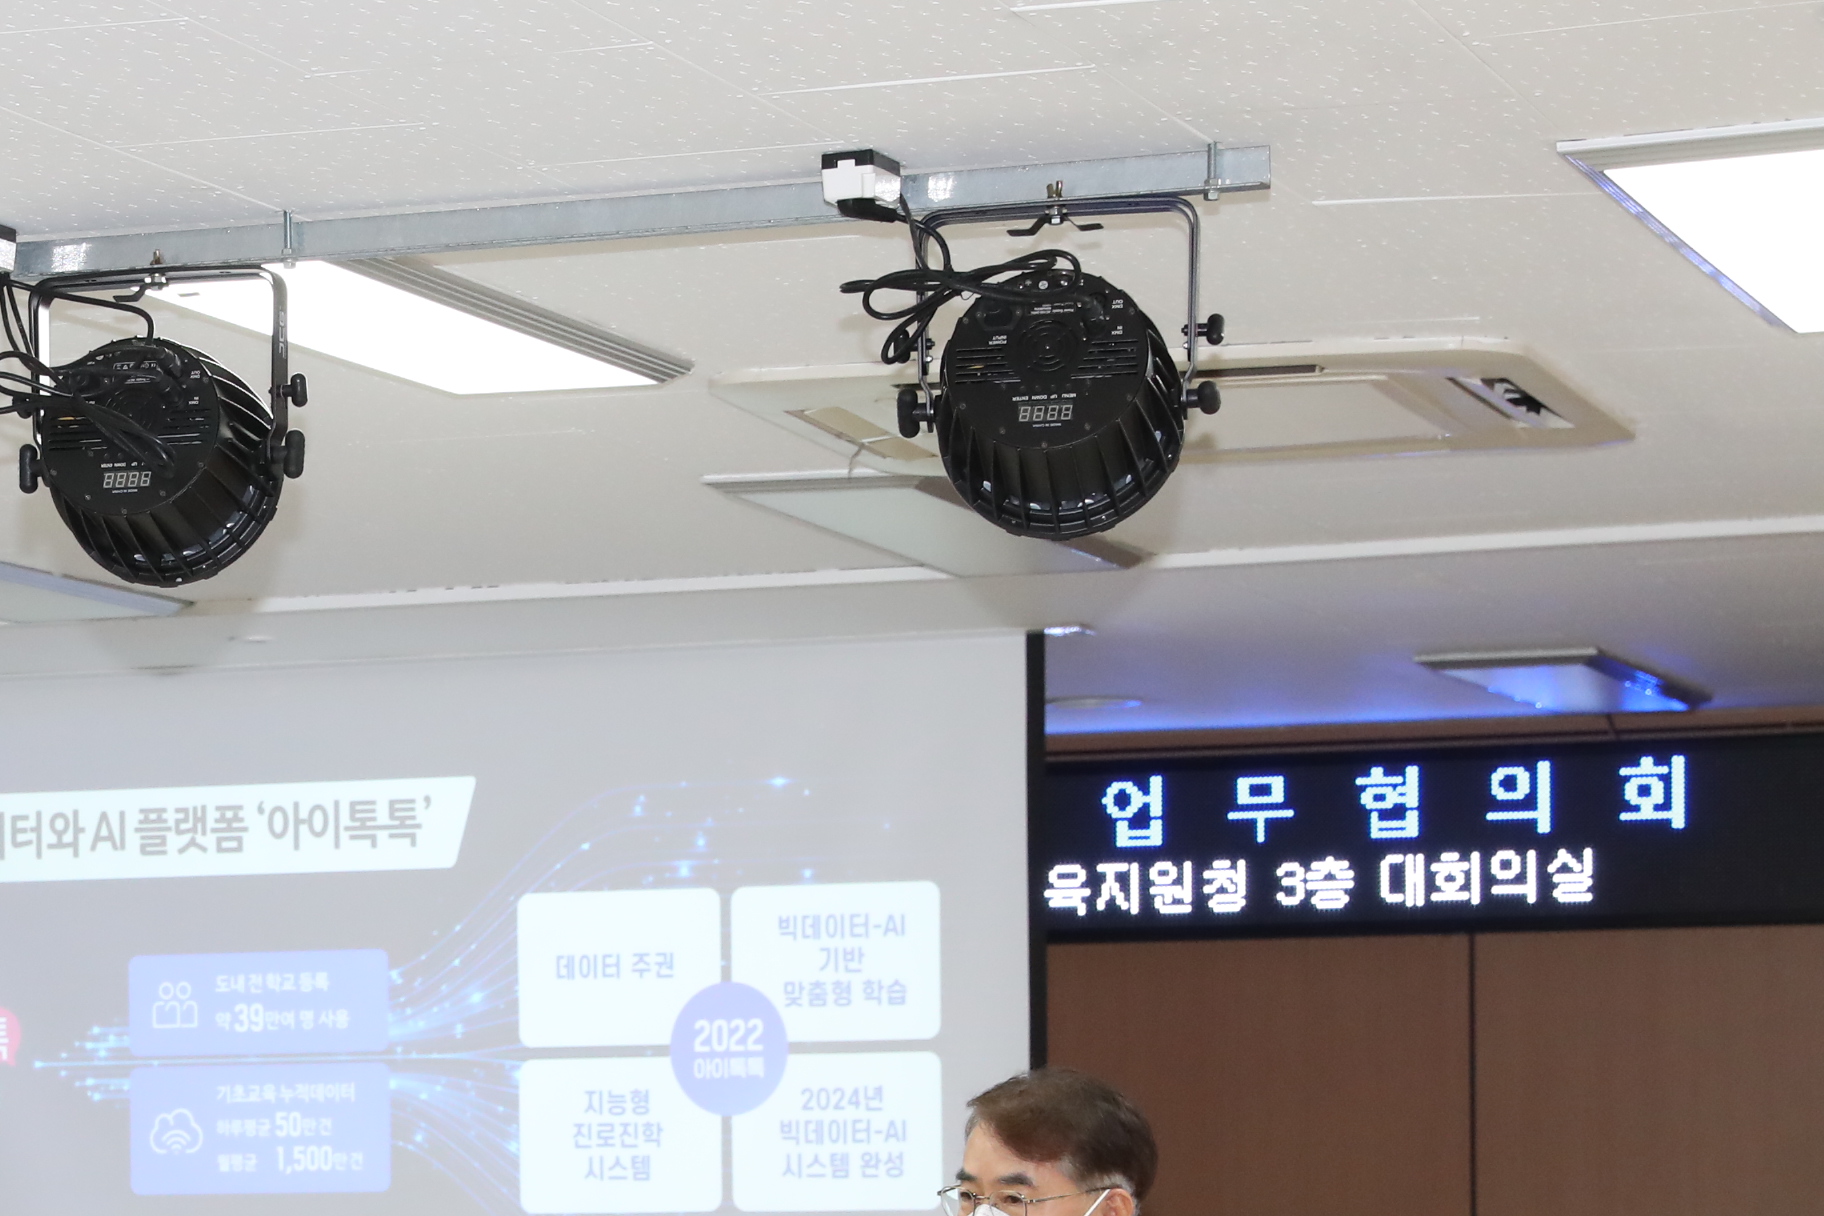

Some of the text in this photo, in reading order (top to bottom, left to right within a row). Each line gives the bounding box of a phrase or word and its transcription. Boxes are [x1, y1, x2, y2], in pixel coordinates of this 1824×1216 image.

[90, 810, 126, 851] AI
[134, 804, 249, 856] 플랫폼
[1043, 848, 1595, 917] 육지원청 3층 대회의실
[556, 952, 675, 980] 데이터 주권
[819, 946, 865, 973] 기반
[784, 978, 906, 1007] 맞춤형 학습
[694, 1018, 764, 1053] 2022
[584, 1088, 650, 1116] 지능형
[801, 1085, 883, 1111] 2024년
[573, 1121, 663, 1148] 진로진학
[584, 1155, 650, 1181] 시스템
[782, 1151, 904, 1179] 시스템 완성
